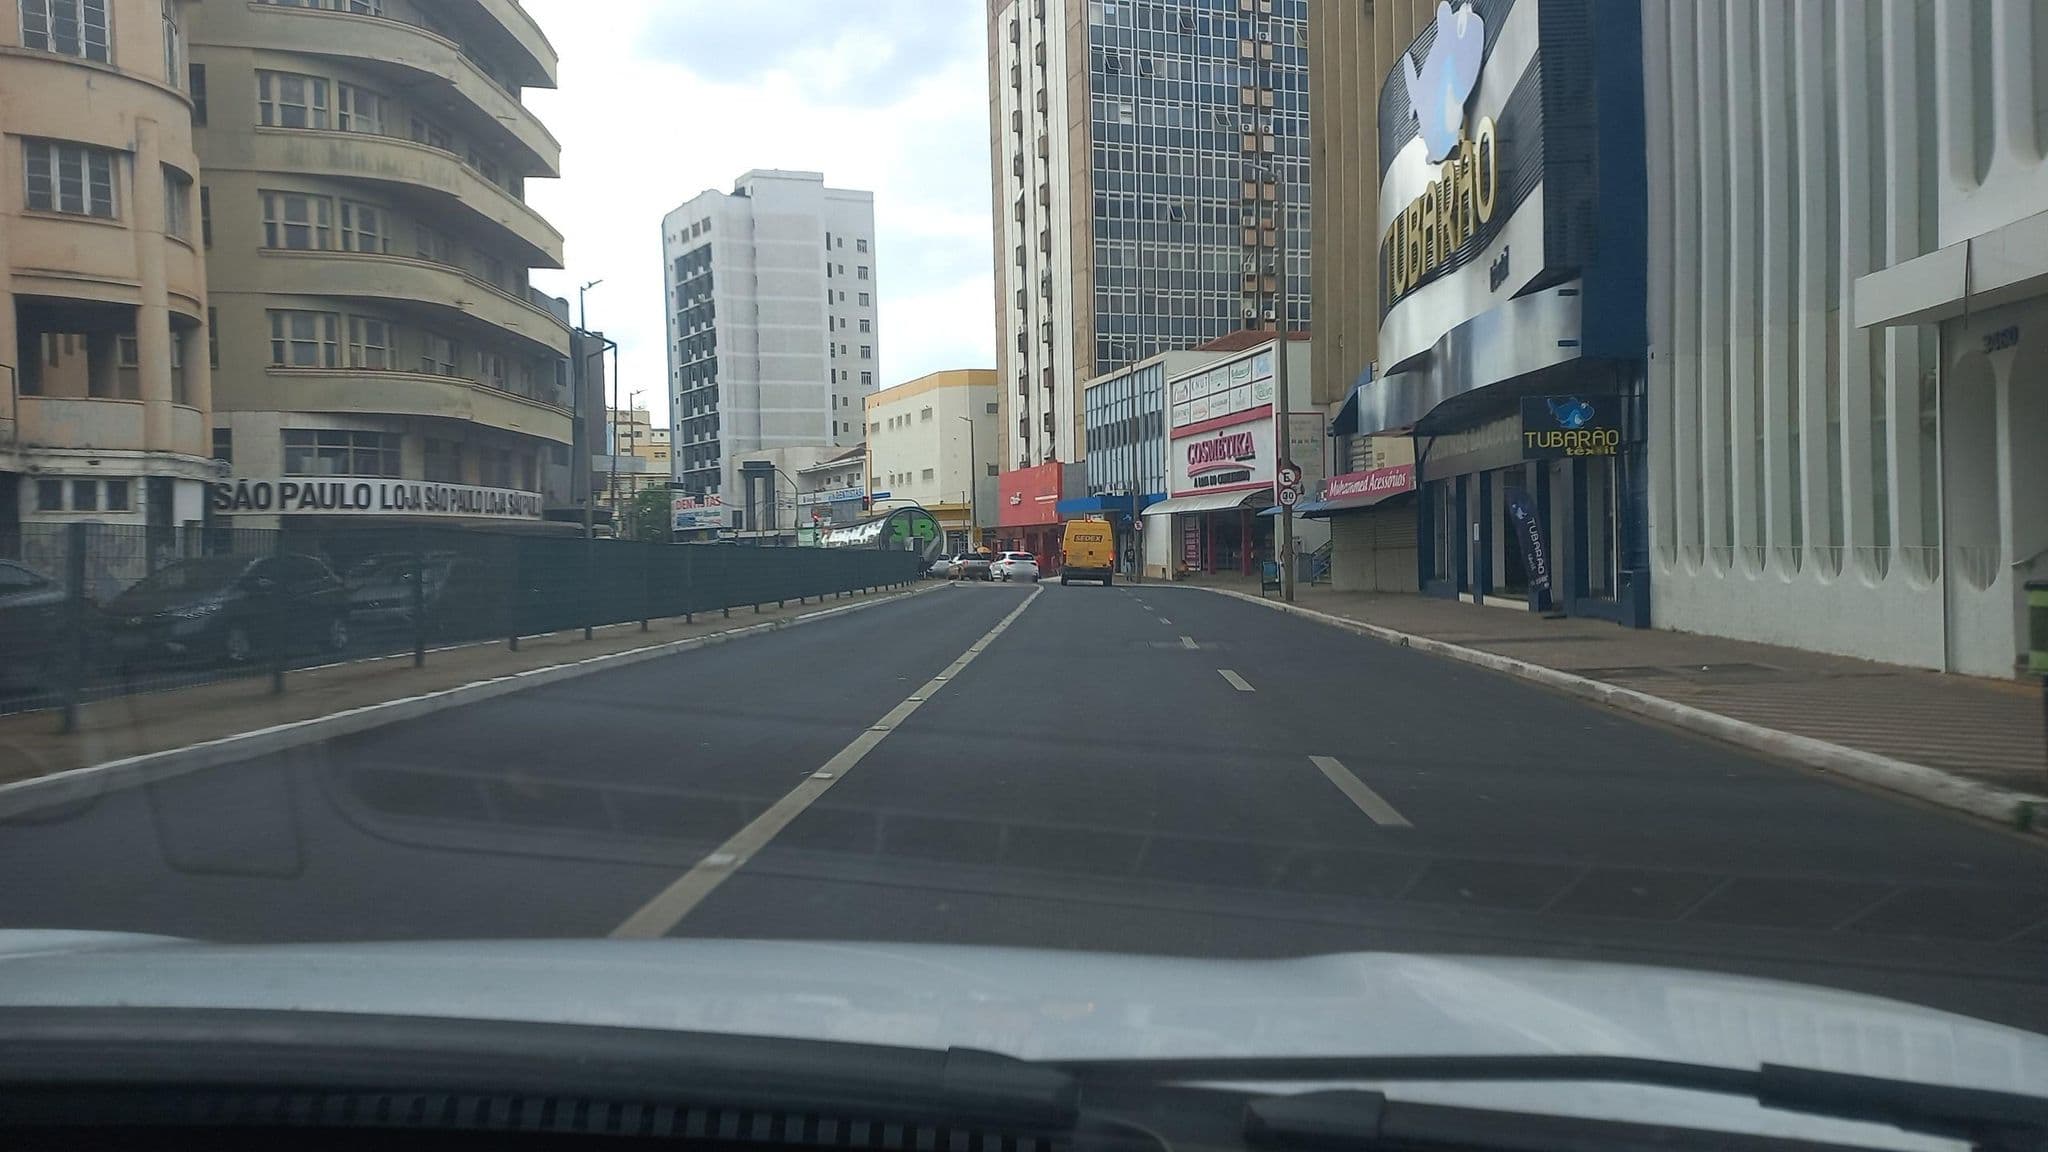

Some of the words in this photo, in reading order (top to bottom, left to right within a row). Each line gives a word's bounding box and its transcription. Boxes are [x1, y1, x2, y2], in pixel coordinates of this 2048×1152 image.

[1524, 427, 1619, 448] TUBARÃO
[1368, 470, 1407, 492] Acessórios
[278, 482, 372, 511] PAULO
[381, 484, 422, 511] LOJA
